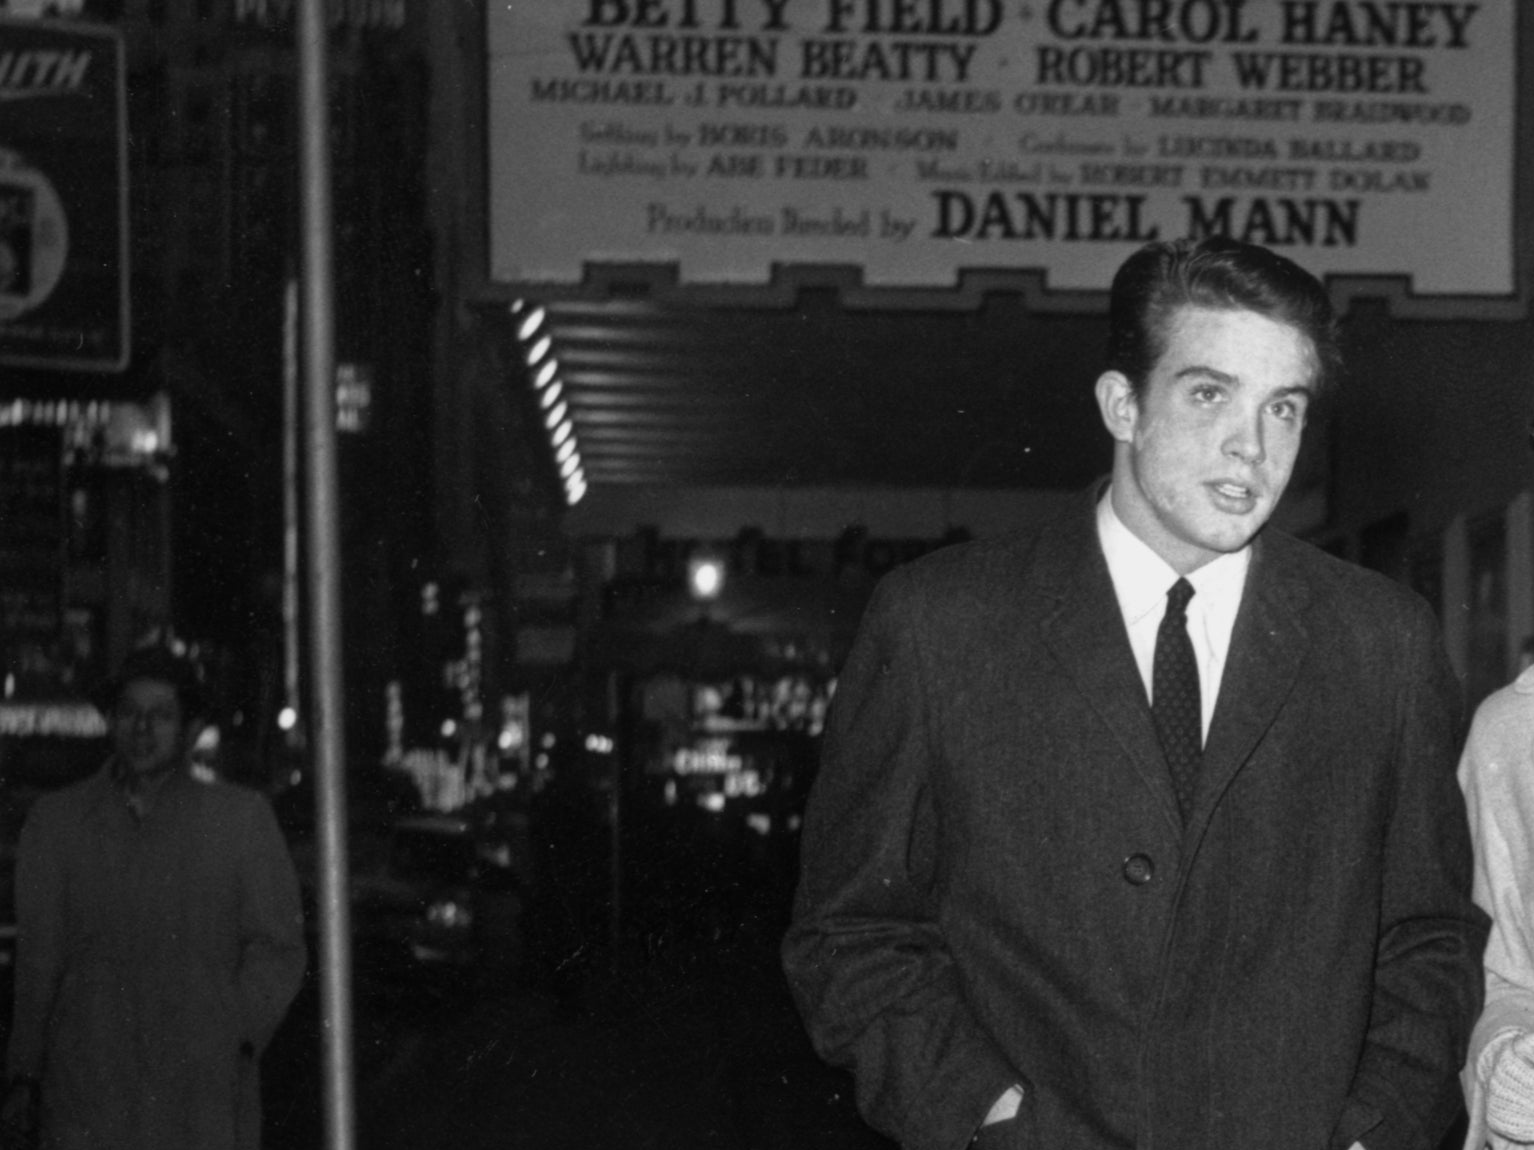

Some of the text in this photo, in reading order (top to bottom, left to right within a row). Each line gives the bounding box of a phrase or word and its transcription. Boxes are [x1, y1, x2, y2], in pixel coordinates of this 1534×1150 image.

[580, 0, 1480, 48] BETTY FIELD CAROL HANEY
[565, 32, 1430, 95] WARREN BEATTY ROBERT WEBBER
[530, 77, 674, 106] MICHAEL
[715, 82, 858, 111] POLLARD
[896, 89, 1001, 114] JAMES
[1149, 96, 1301, 122] MARGARET
[699, 122, 789, 147] BORIS
[803, 126, 958, 151] ARONSON
[1157, 134, 1278, 160] LUCINDA
[1288, 138, 1423, 164] BALLARD
[706, 153, 766, 178] ABE
[774, 154, 869, 180] FEDER
[1079, 162, 1184, 188] ROBERT
[646, 202, 775, 235] Production
[879, 208, 918, 243] by
[930, 188, 1160, 243] DANIEL
[1183, 195, 1362, 248] MANN
